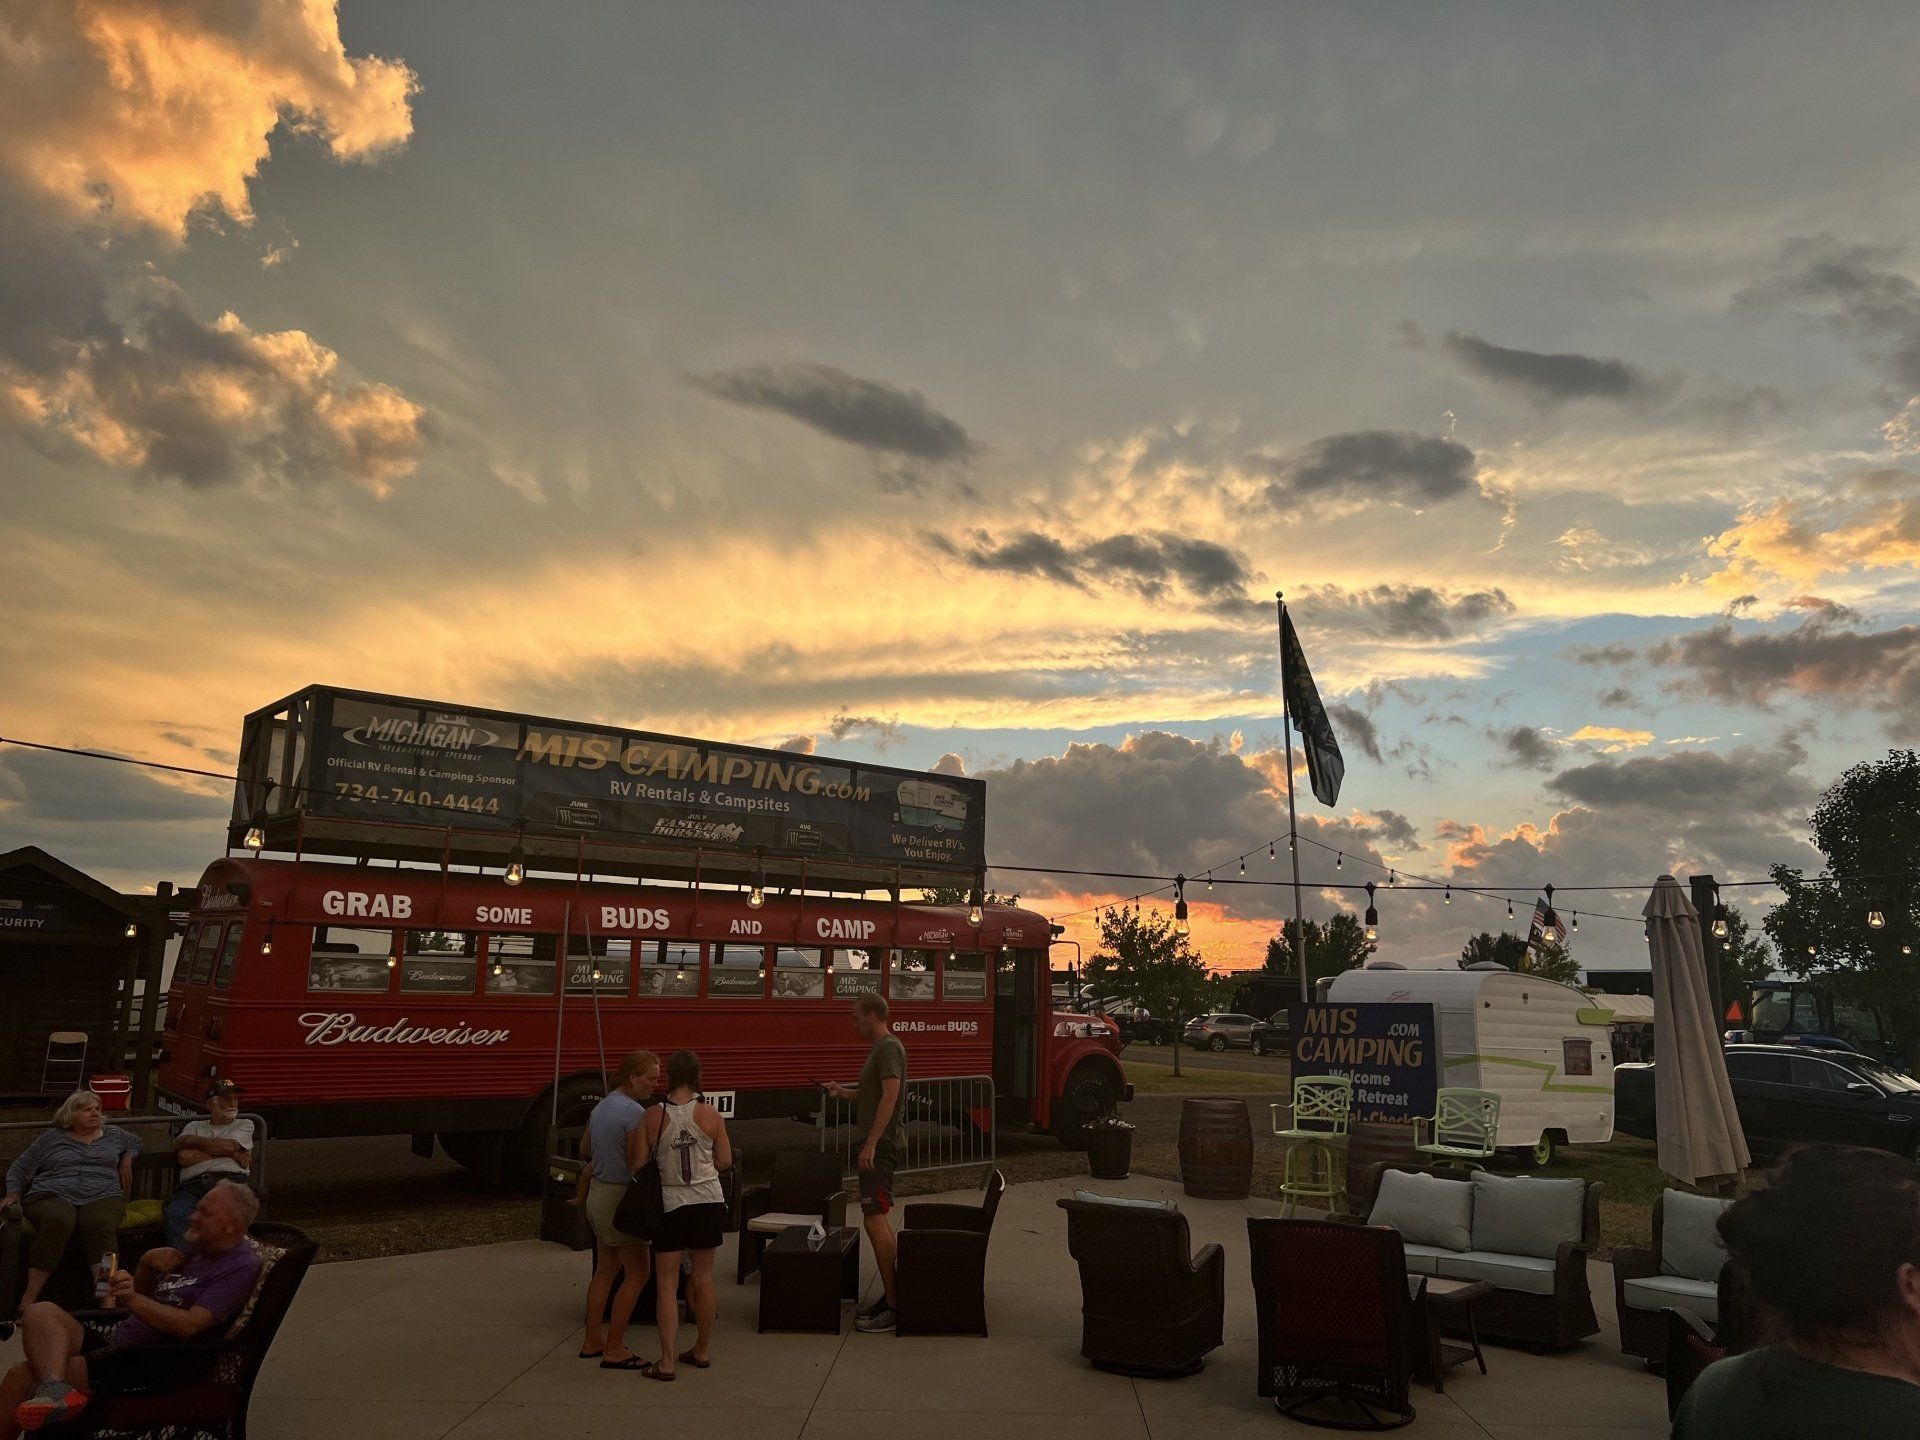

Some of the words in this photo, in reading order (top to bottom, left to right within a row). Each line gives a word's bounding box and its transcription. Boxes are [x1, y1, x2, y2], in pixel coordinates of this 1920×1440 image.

[365, 715, 477, 750] MICHIGAN
[378, 744, 439, 758] INTERNATIONAL
[444, 751, 482, 762] SPEEDWAY
[515, 732, 612, 770] MIS
[327, 757, 366, 770] Official
[368, 762, 381, 772] RV
[383, 764, 416, 776] Rental
[419, 768, 427, 777] &
[428, 769, 473, 783] Camping
[475, 773, 516, 786] Sponsor
[335, 782, 499, 815] 734-740-4444
[569, 800, 589, 809] JUNE
[610, 780, 631, 796] RV
[635, 783, 695, 803] Rentals
[700, 790, 711, 805] &
[715, 791, 790, 812] Campsites
[688, 813, 707, 821] JULY
[892, 834, 907, 845] We
[909, 835, 943, 848] Deliver
[904, 847, 924, 858] You
[322, 890, 412, 919] GRAB
[475, 905, 532, 925] SOME
[601, 906, 671, 931] BUDS
[730, 919, 763, 935] AND
[816, 917, 876, 940] CAMP
[407, 970, 467, 982] Budweiser
[712, 976, 758, 987] Budweiser
[839, 976, 858, 985] MIS
[836, 985, 878, 994] CAMPING
[298, 1012, 510, 1046] Budweiser
[892, 1021, 926, 1032] GRAB
[926, 1024, 947, 1032] SOME
[947, 1021, 978, 1033] BUDS
[1303, 1008, 1358, 1035] MIS
[1388, 1023, 1420, 1037] .COM
[1296, 1036, 1424, 1068] CAMPING
[1358, 1089, 1409, 1107] Retreat
